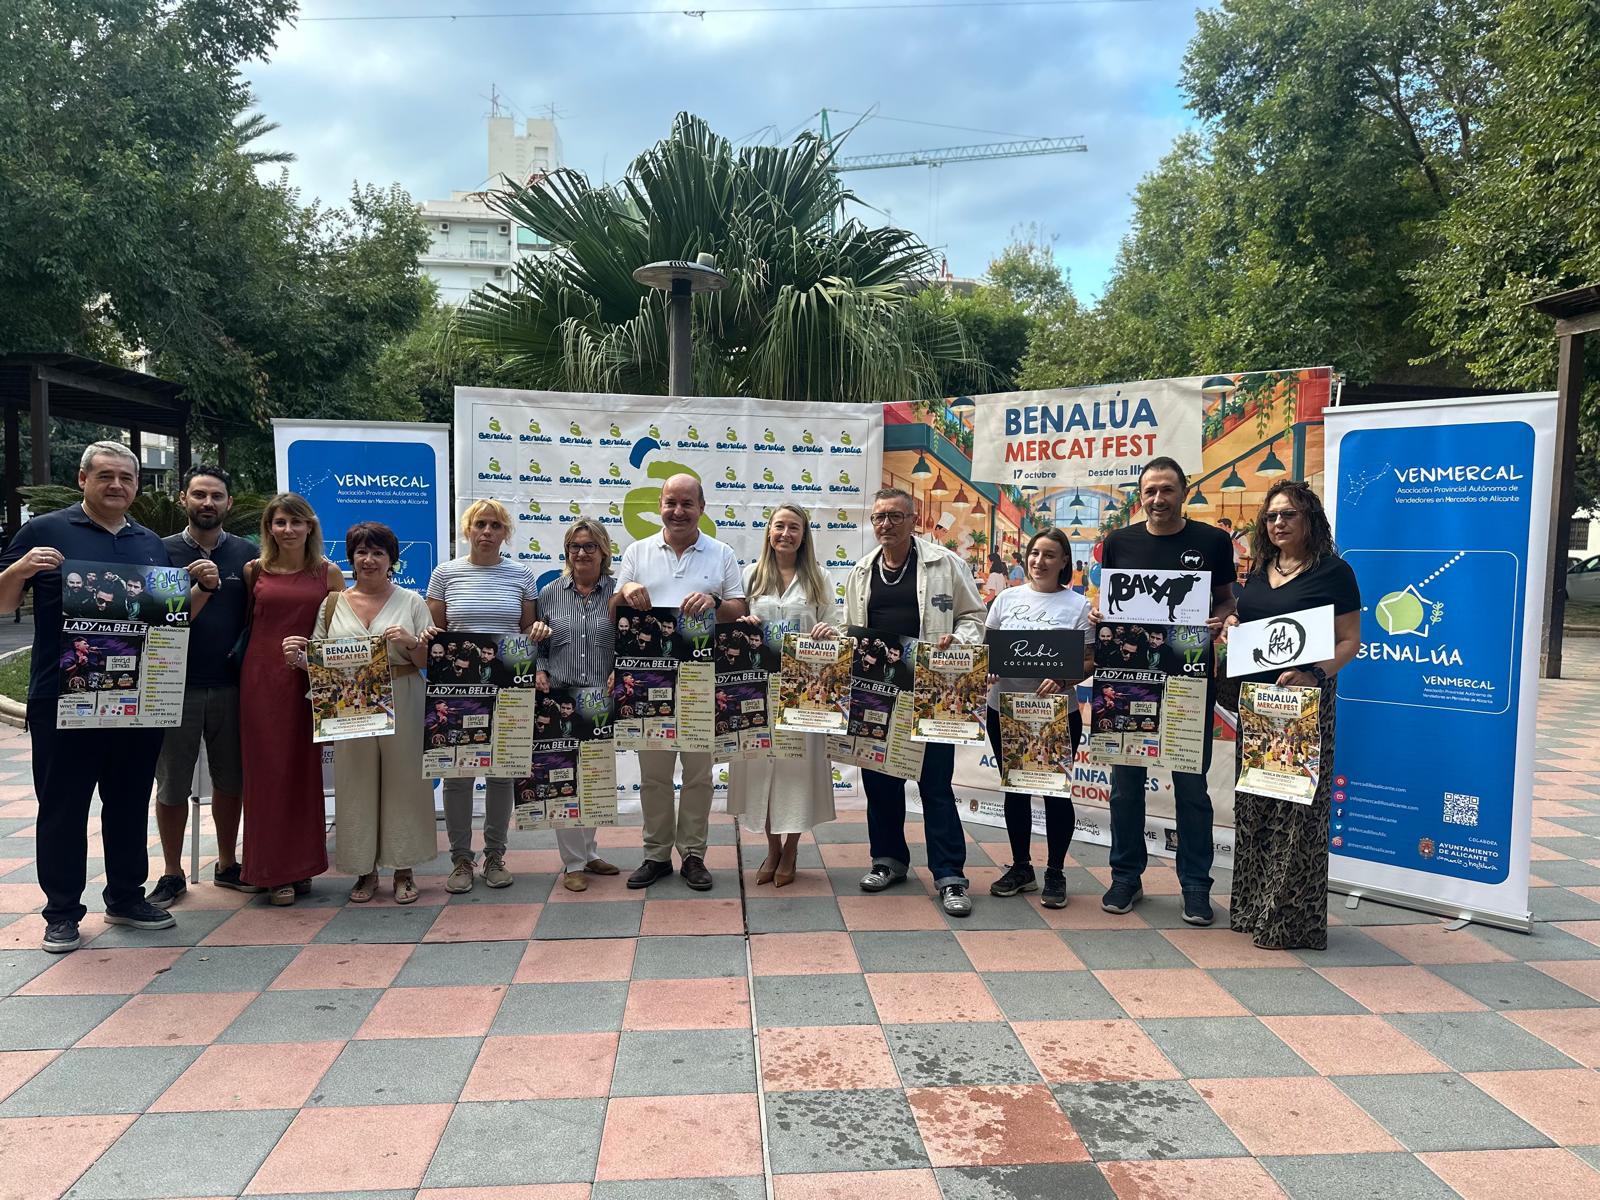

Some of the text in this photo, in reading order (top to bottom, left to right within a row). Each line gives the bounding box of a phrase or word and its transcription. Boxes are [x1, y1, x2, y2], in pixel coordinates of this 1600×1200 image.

[1005, 390, 1157, 436] BENALÚA
[1005, 434, 1157, 463] MERCAT FEST
[1013, 469, 1057, 479] 17 octubre
[1088, 469, 1114, 477] Desde
[1115, 468, 1128, 476] las
[1394, 464, 1524, 483] VENMERCAL
[335, 474, 430, 488] VENMERCAL
[1112, 573, 1173, 604] BAKA
[165, 596, 186, 612] 17
[166, 612, 188, 622] OCT
[63, 620, 98, 631] LADY
[114, 624, 148, 634] BELLE
[1270, 626, 1286, 643] GA
[692, 634, 710, 650] 17
[692, 648, 712, 658] OCT
[1184, 648, 1203, 663] 17
[1356, 642, 1464, 666] BENALÚA
[514, 661, 532, 676] 17
[614, 659, 640, 667] LADY
[652, 660, 679, 668] BELLE
[1183, 662, 1205, 672] OCT
[514, 674, 534, 684] OCT
[1094, 670, 1122, 679] LADY
[1136, 673, 1167, 682] BELLE
[1422, 675, 1495, 690] VENMERCAL
[426, 686, 455, 694] LADY
[592, 712, 608, 727] 17
[593, 725, 612, 736] OCT
[1439, 842, 1499, 858] AYUNTAMIENTO
[1451, 851, 1488, 862] ALICANTE
